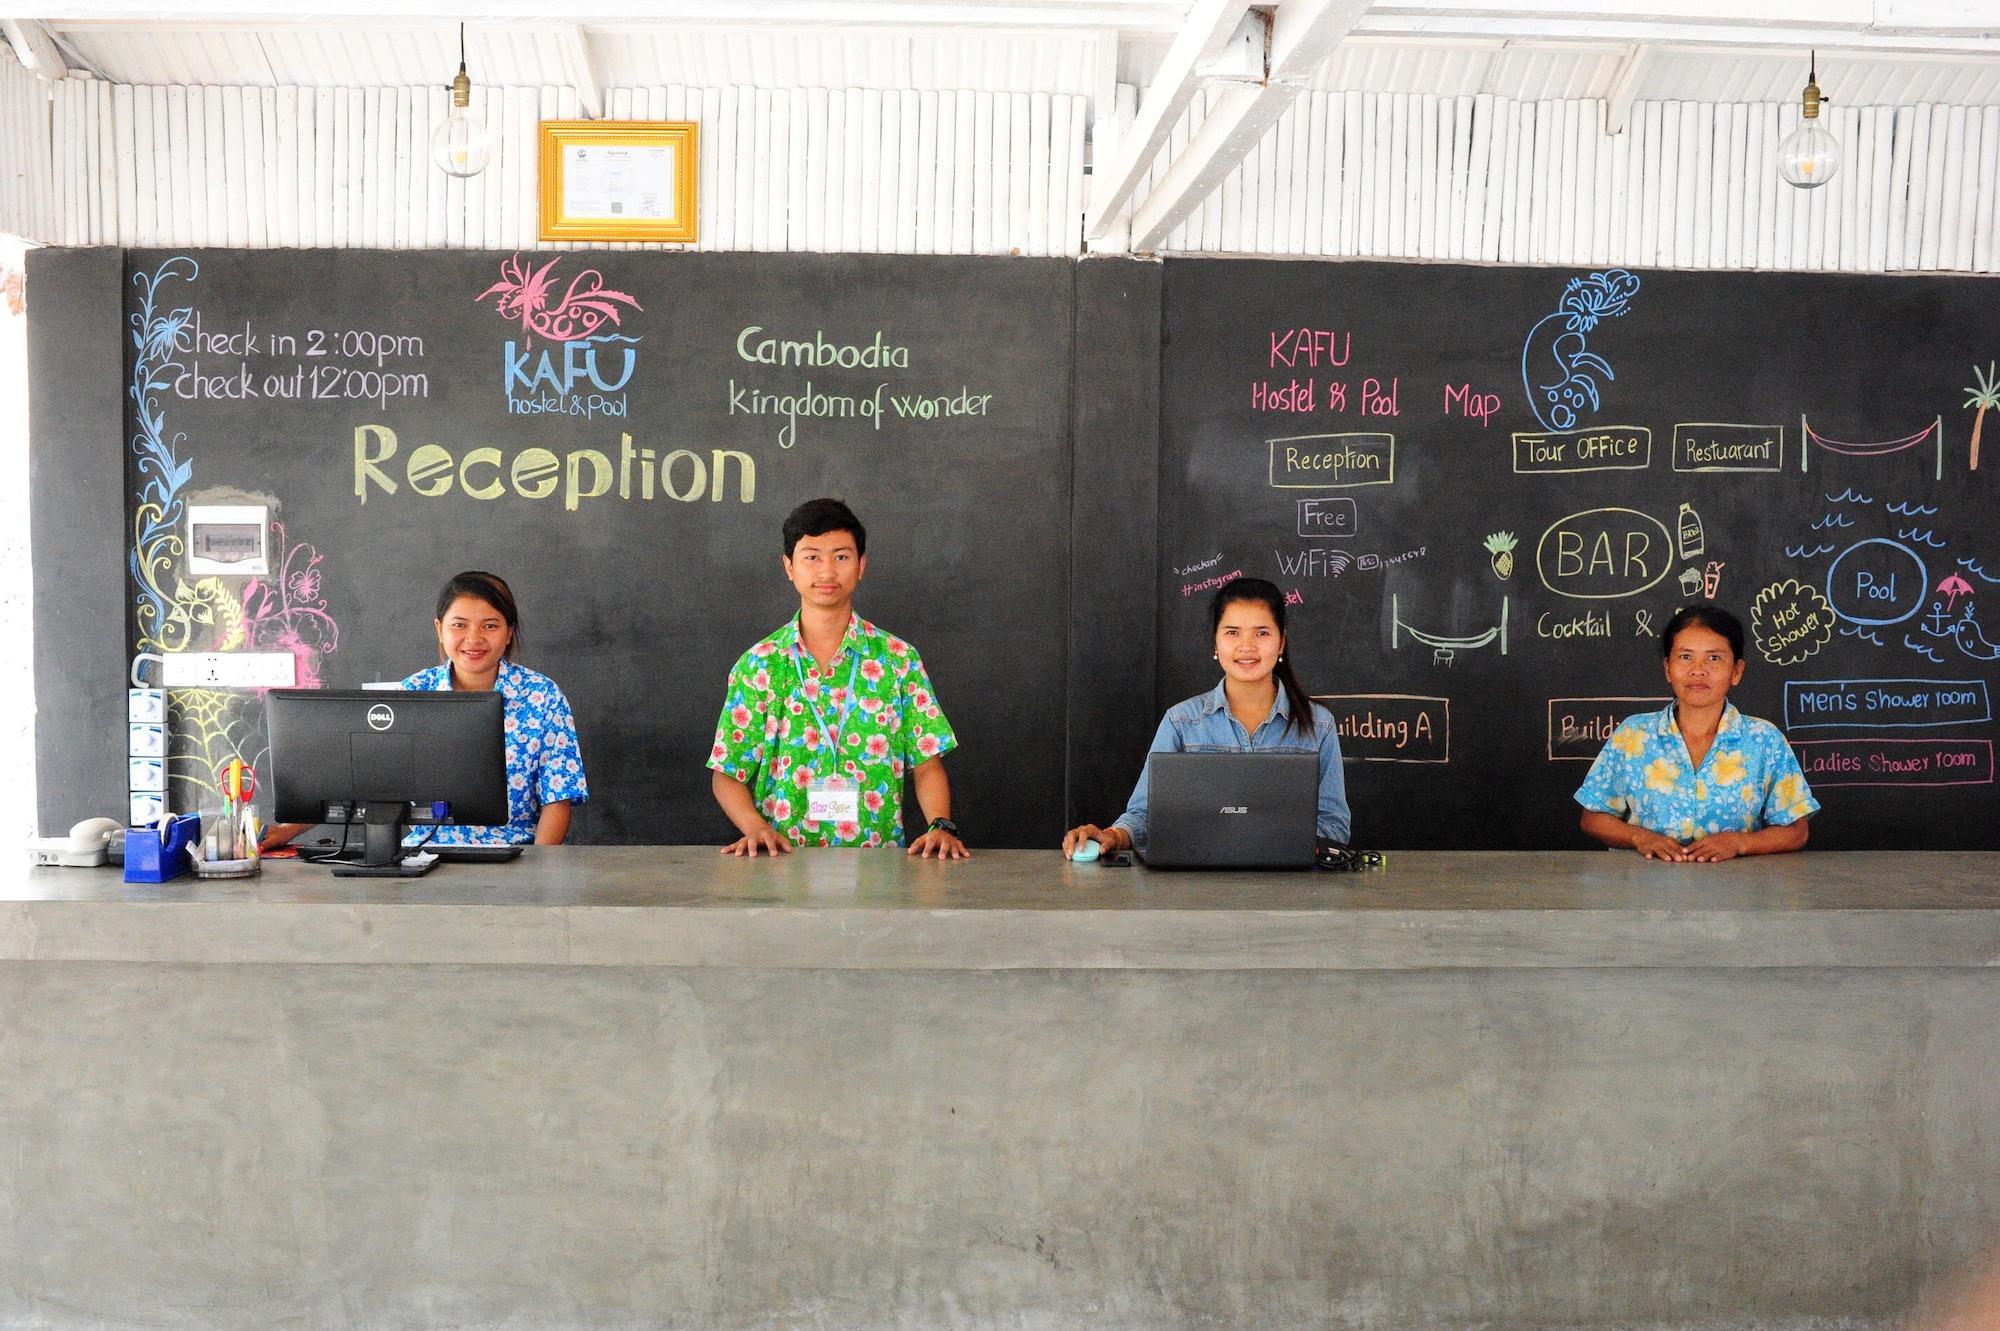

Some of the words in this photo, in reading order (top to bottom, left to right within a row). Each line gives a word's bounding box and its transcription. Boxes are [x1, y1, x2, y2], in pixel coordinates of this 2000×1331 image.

[271, 334, 296, 356] in
[736, 326, 909, 368] Cambodia
[1269, 328, 1350, 368] KAFU
[505, 341, 636, 396] KAFU
[264, 364, 304, 398] out
[309, 365, 428, 410] 12:00pm
[1252, 378, 1316, 413] Hostel
[1330, 382, 1347, 412] &
[1361, 377, 1400, 416] Pool
[569, 394, 586, 415] &
[859, 382, 889, 430] of
[1444, 383, 1501, 428] Map
[1286, 445, 1380, 480] Reception
[1521, 439, 1566, 463] Tour
[1686, 438, 1775, 463] Restuarant
[354, 424, 756, 511] Reception
[1304, 502, 1346, 526] Free
[1274, 548, 1327, 577] WiFi
[1558, 531, 1650, 578] BAR
[1857, 572, 1897, 602] Pool
[1537, 610, 1612, 639] Cocktail
[1772, 602, 1800, 630] Hot
[1768, 612, 1819, 652] Shower
[1800, 683, 1857, 713] Men's
[1935, 691, 1976, 707] room
[370, 713, 391, 721] DELL
[1337, 711, 1408, 748] uilding
[1415, 711, 1432, 744] A
[1802, 750, 1861, 773] Ladies
[1935, 751, 1976, 767] room
[1219, 806, 1248, 814] ASUS
